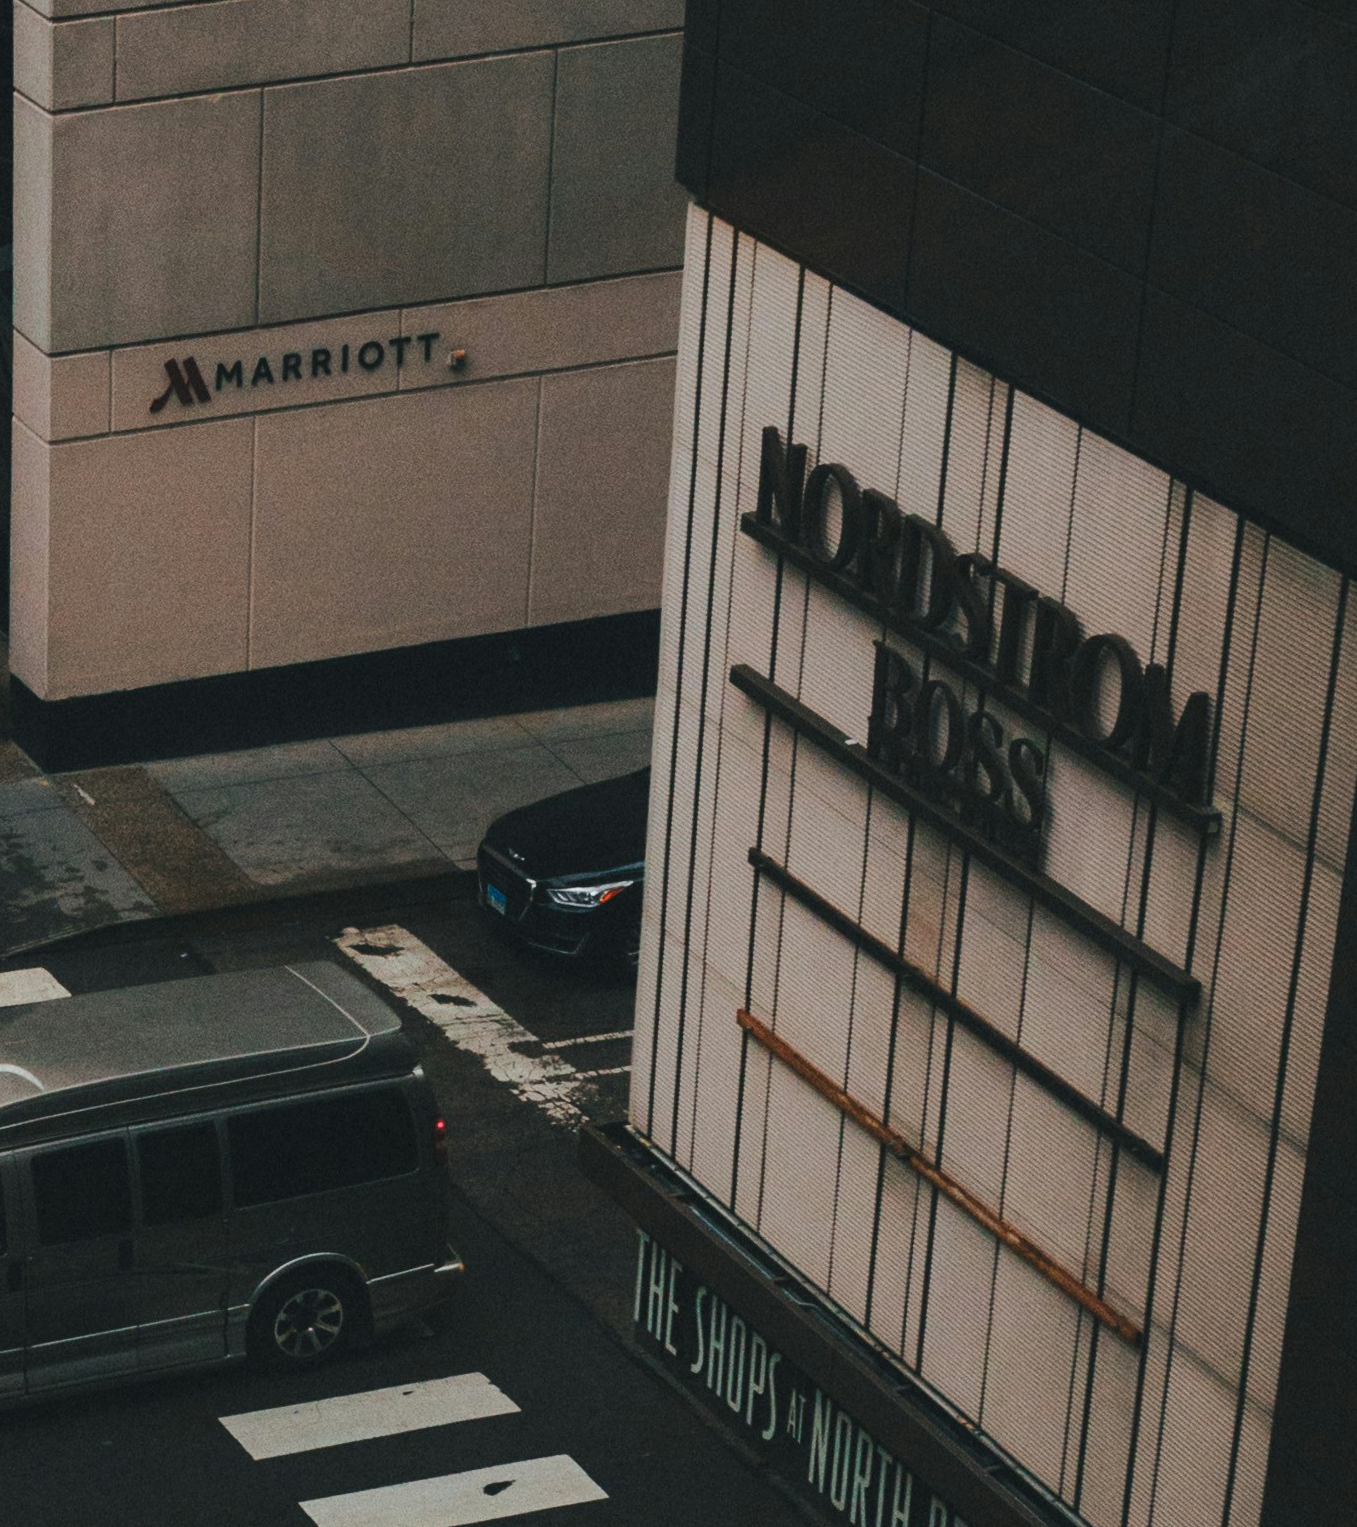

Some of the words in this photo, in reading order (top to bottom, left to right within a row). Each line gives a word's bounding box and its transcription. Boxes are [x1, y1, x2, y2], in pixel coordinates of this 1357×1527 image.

[215, 333, 441, 392] MARRIOTT
[759, 426, 1215, 814] NORDSTROM
[867, 639, 1049, 833] BOSS
[634, 1226, 683, 1357] THE
[690, 1286, 782, 1441] SHOPS
[787, 1387, 807, 1444] AT
